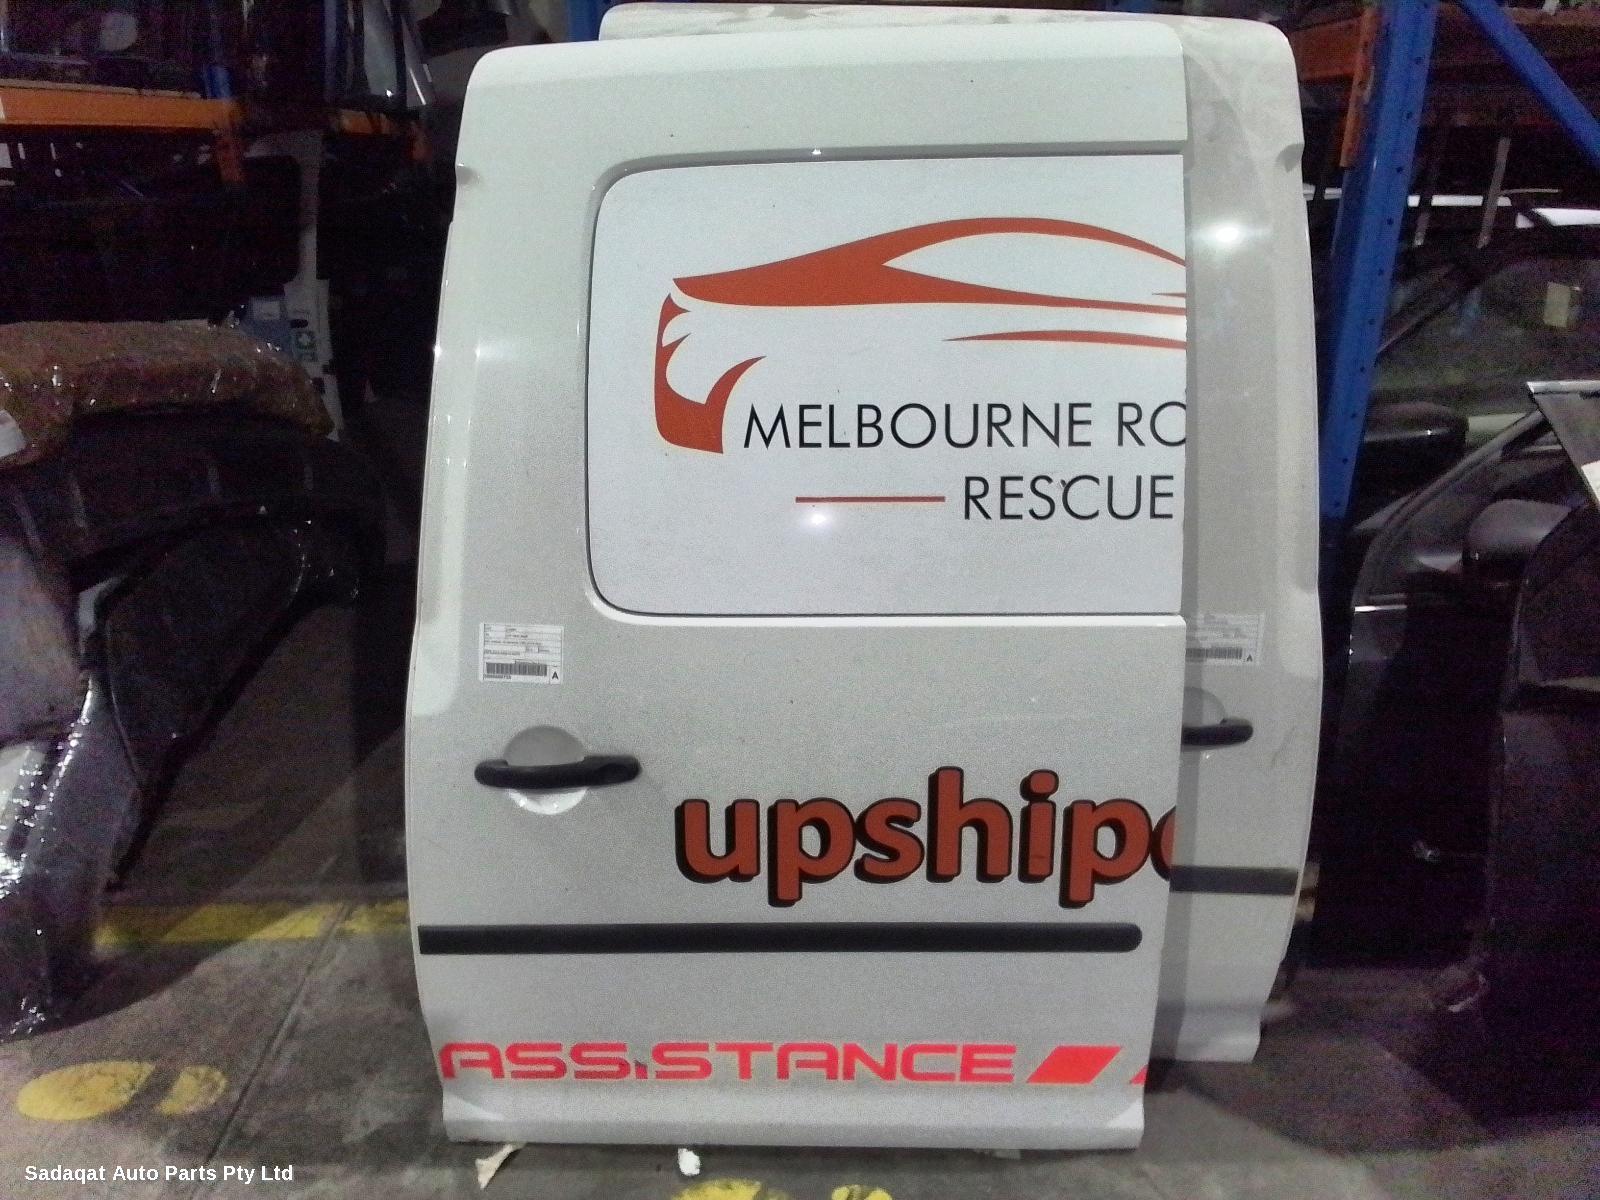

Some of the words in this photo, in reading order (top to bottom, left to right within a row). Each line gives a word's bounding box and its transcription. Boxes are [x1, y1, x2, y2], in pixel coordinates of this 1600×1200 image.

[743, 402, 1092, 449] MELBOURNE
[964, 474, 1175, 520] RESCUE
[551, 671, 559, 680] A
